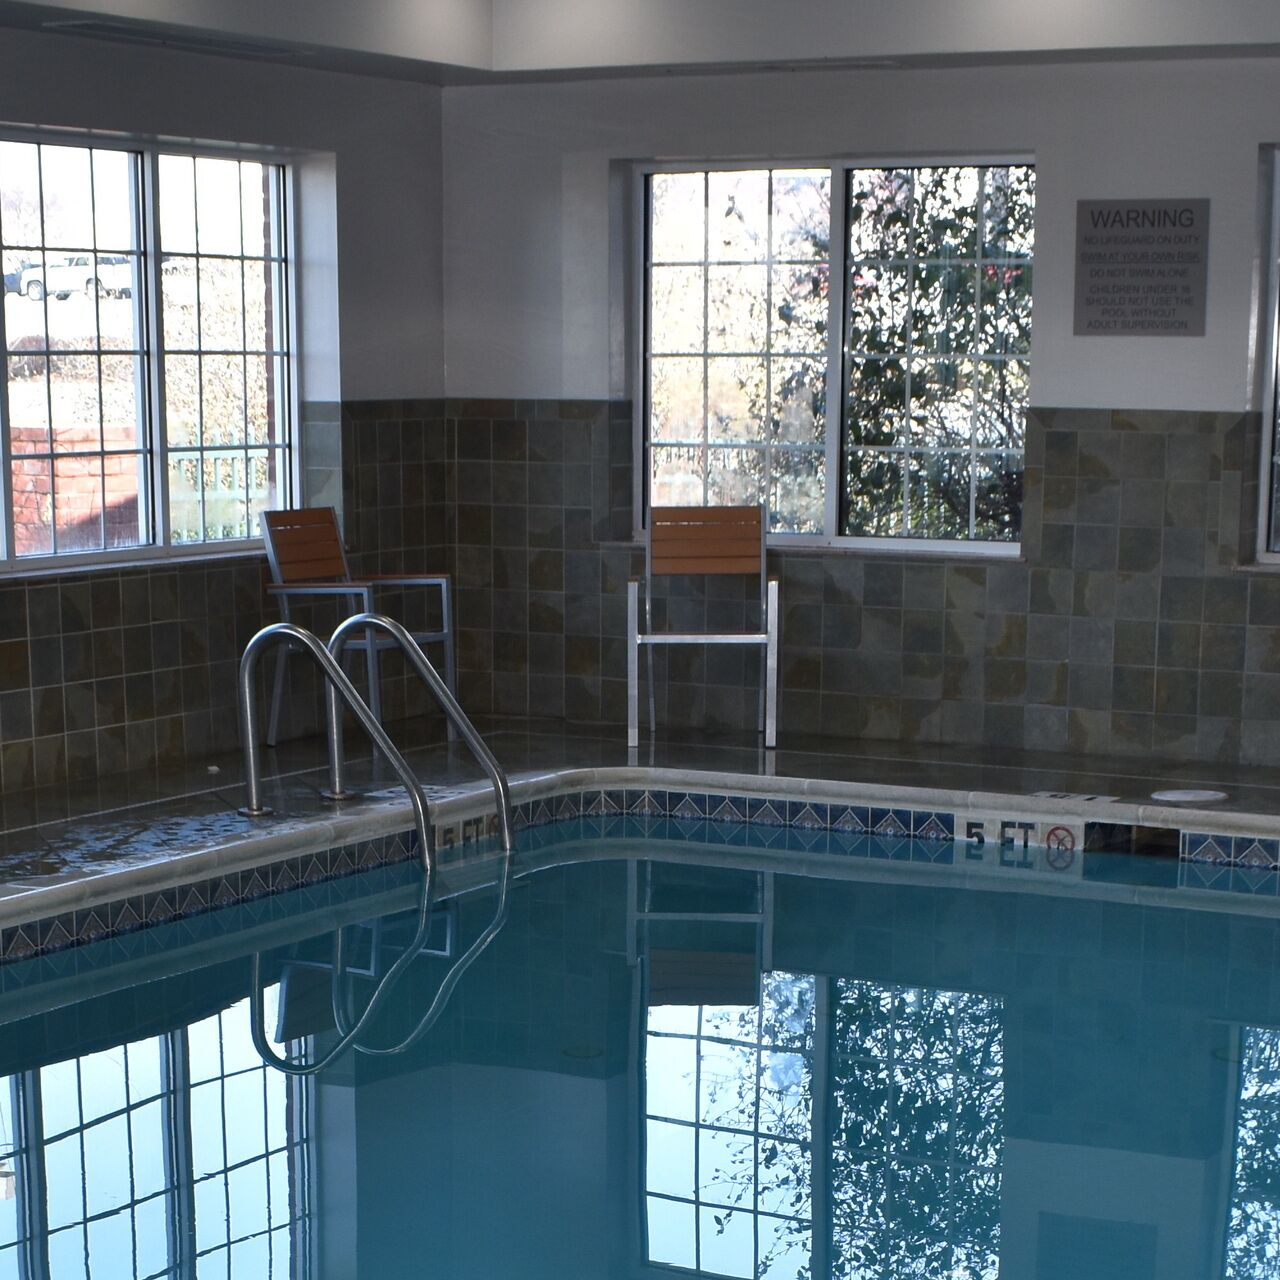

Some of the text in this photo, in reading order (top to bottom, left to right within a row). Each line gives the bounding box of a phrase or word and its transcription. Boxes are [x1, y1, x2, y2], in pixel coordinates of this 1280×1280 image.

[1090, 208, 1194, 228] WARNING
[1084, 235, 1200, 245] NO LIFEGUARD ON DUTY
[1109, 252, 1119, 261] AT
[1122, 252, 1150, 261] YOUR
[1151, 252, 1176, 261] OWN
[1090, 268, 1189, 278] DO NOT SWIM ALONE
[1089, 284, 1140, 294] CHILDREN
[1142, 284, 1177, 294] UNDER
[1086, 296, 1195, 306] SHOULD NOT USE THE
[1102, 308, 1176, 318] POOL WITHOUT
[1086, 320, 1188, 329] ADULT SUPERVISION
[966, 821, 1035, 849] 5 FT
